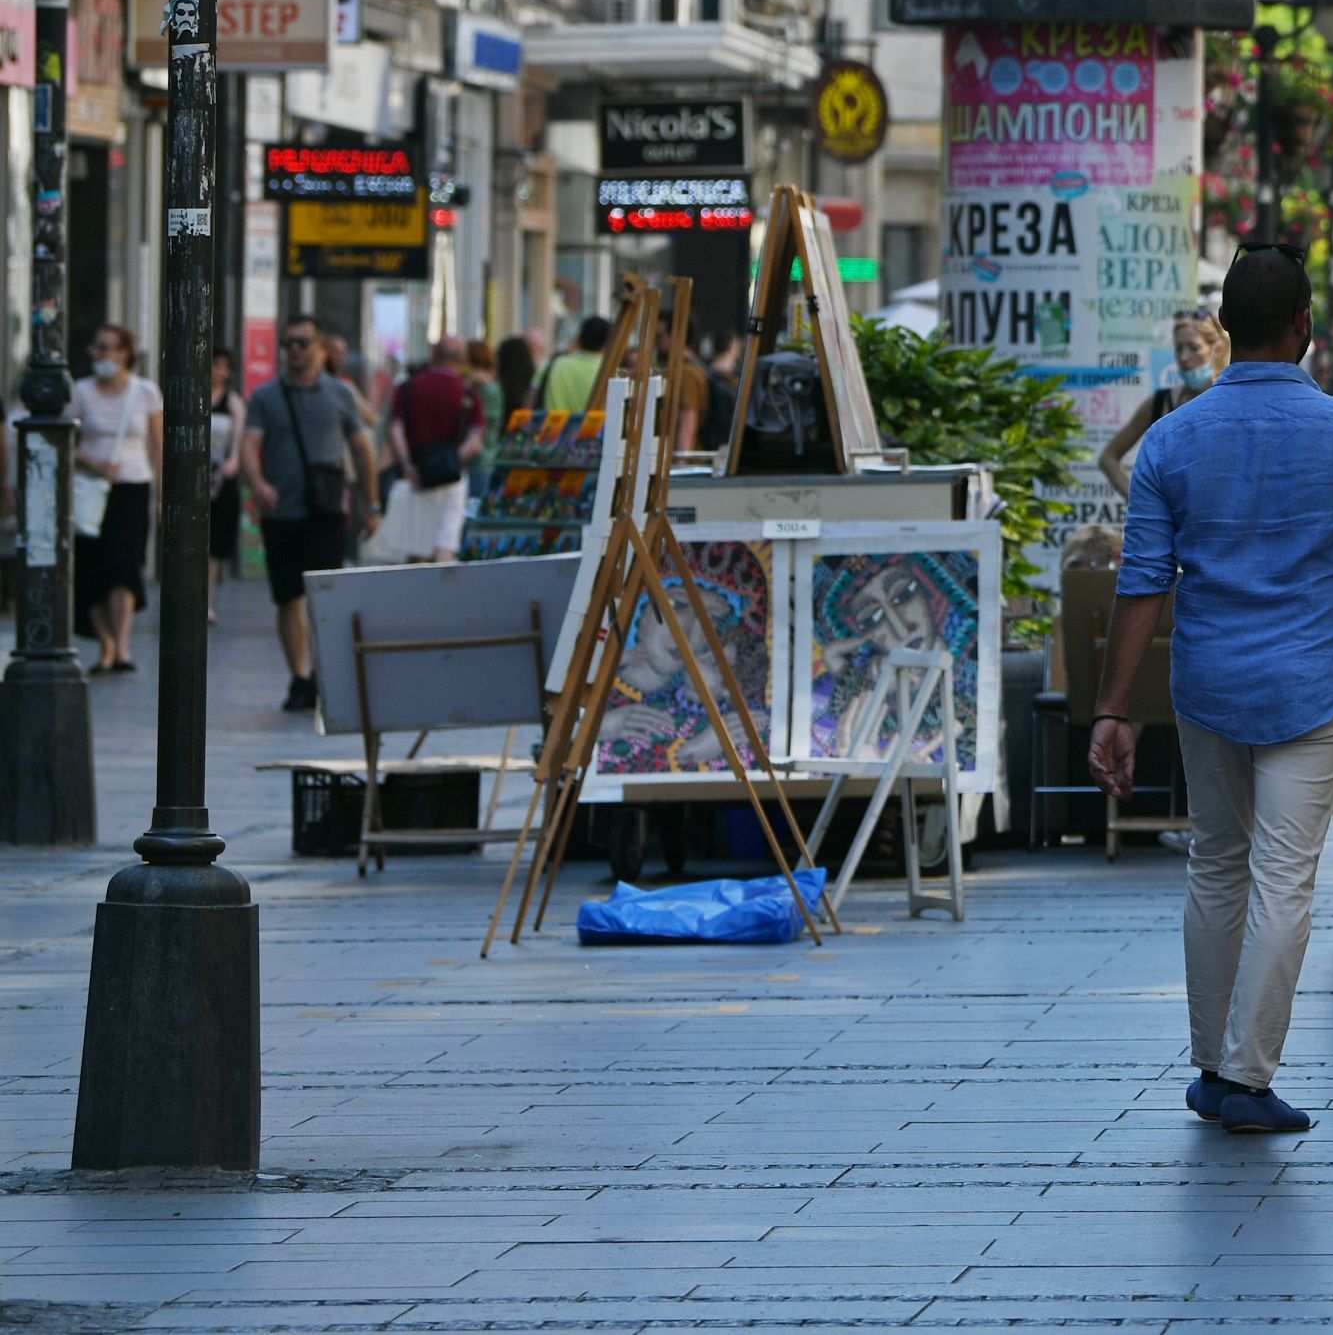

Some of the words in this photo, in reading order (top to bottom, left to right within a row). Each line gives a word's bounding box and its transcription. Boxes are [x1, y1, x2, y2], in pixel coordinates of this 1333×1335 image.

[1021, 23, 1148, 57] КРЕЗА
[952, 102, 1147, 142] ШАМПОНИ
[1126, 194, 1181, 213] КРЕЗА
[949, 202, 1077, 256] КРЕЗА
